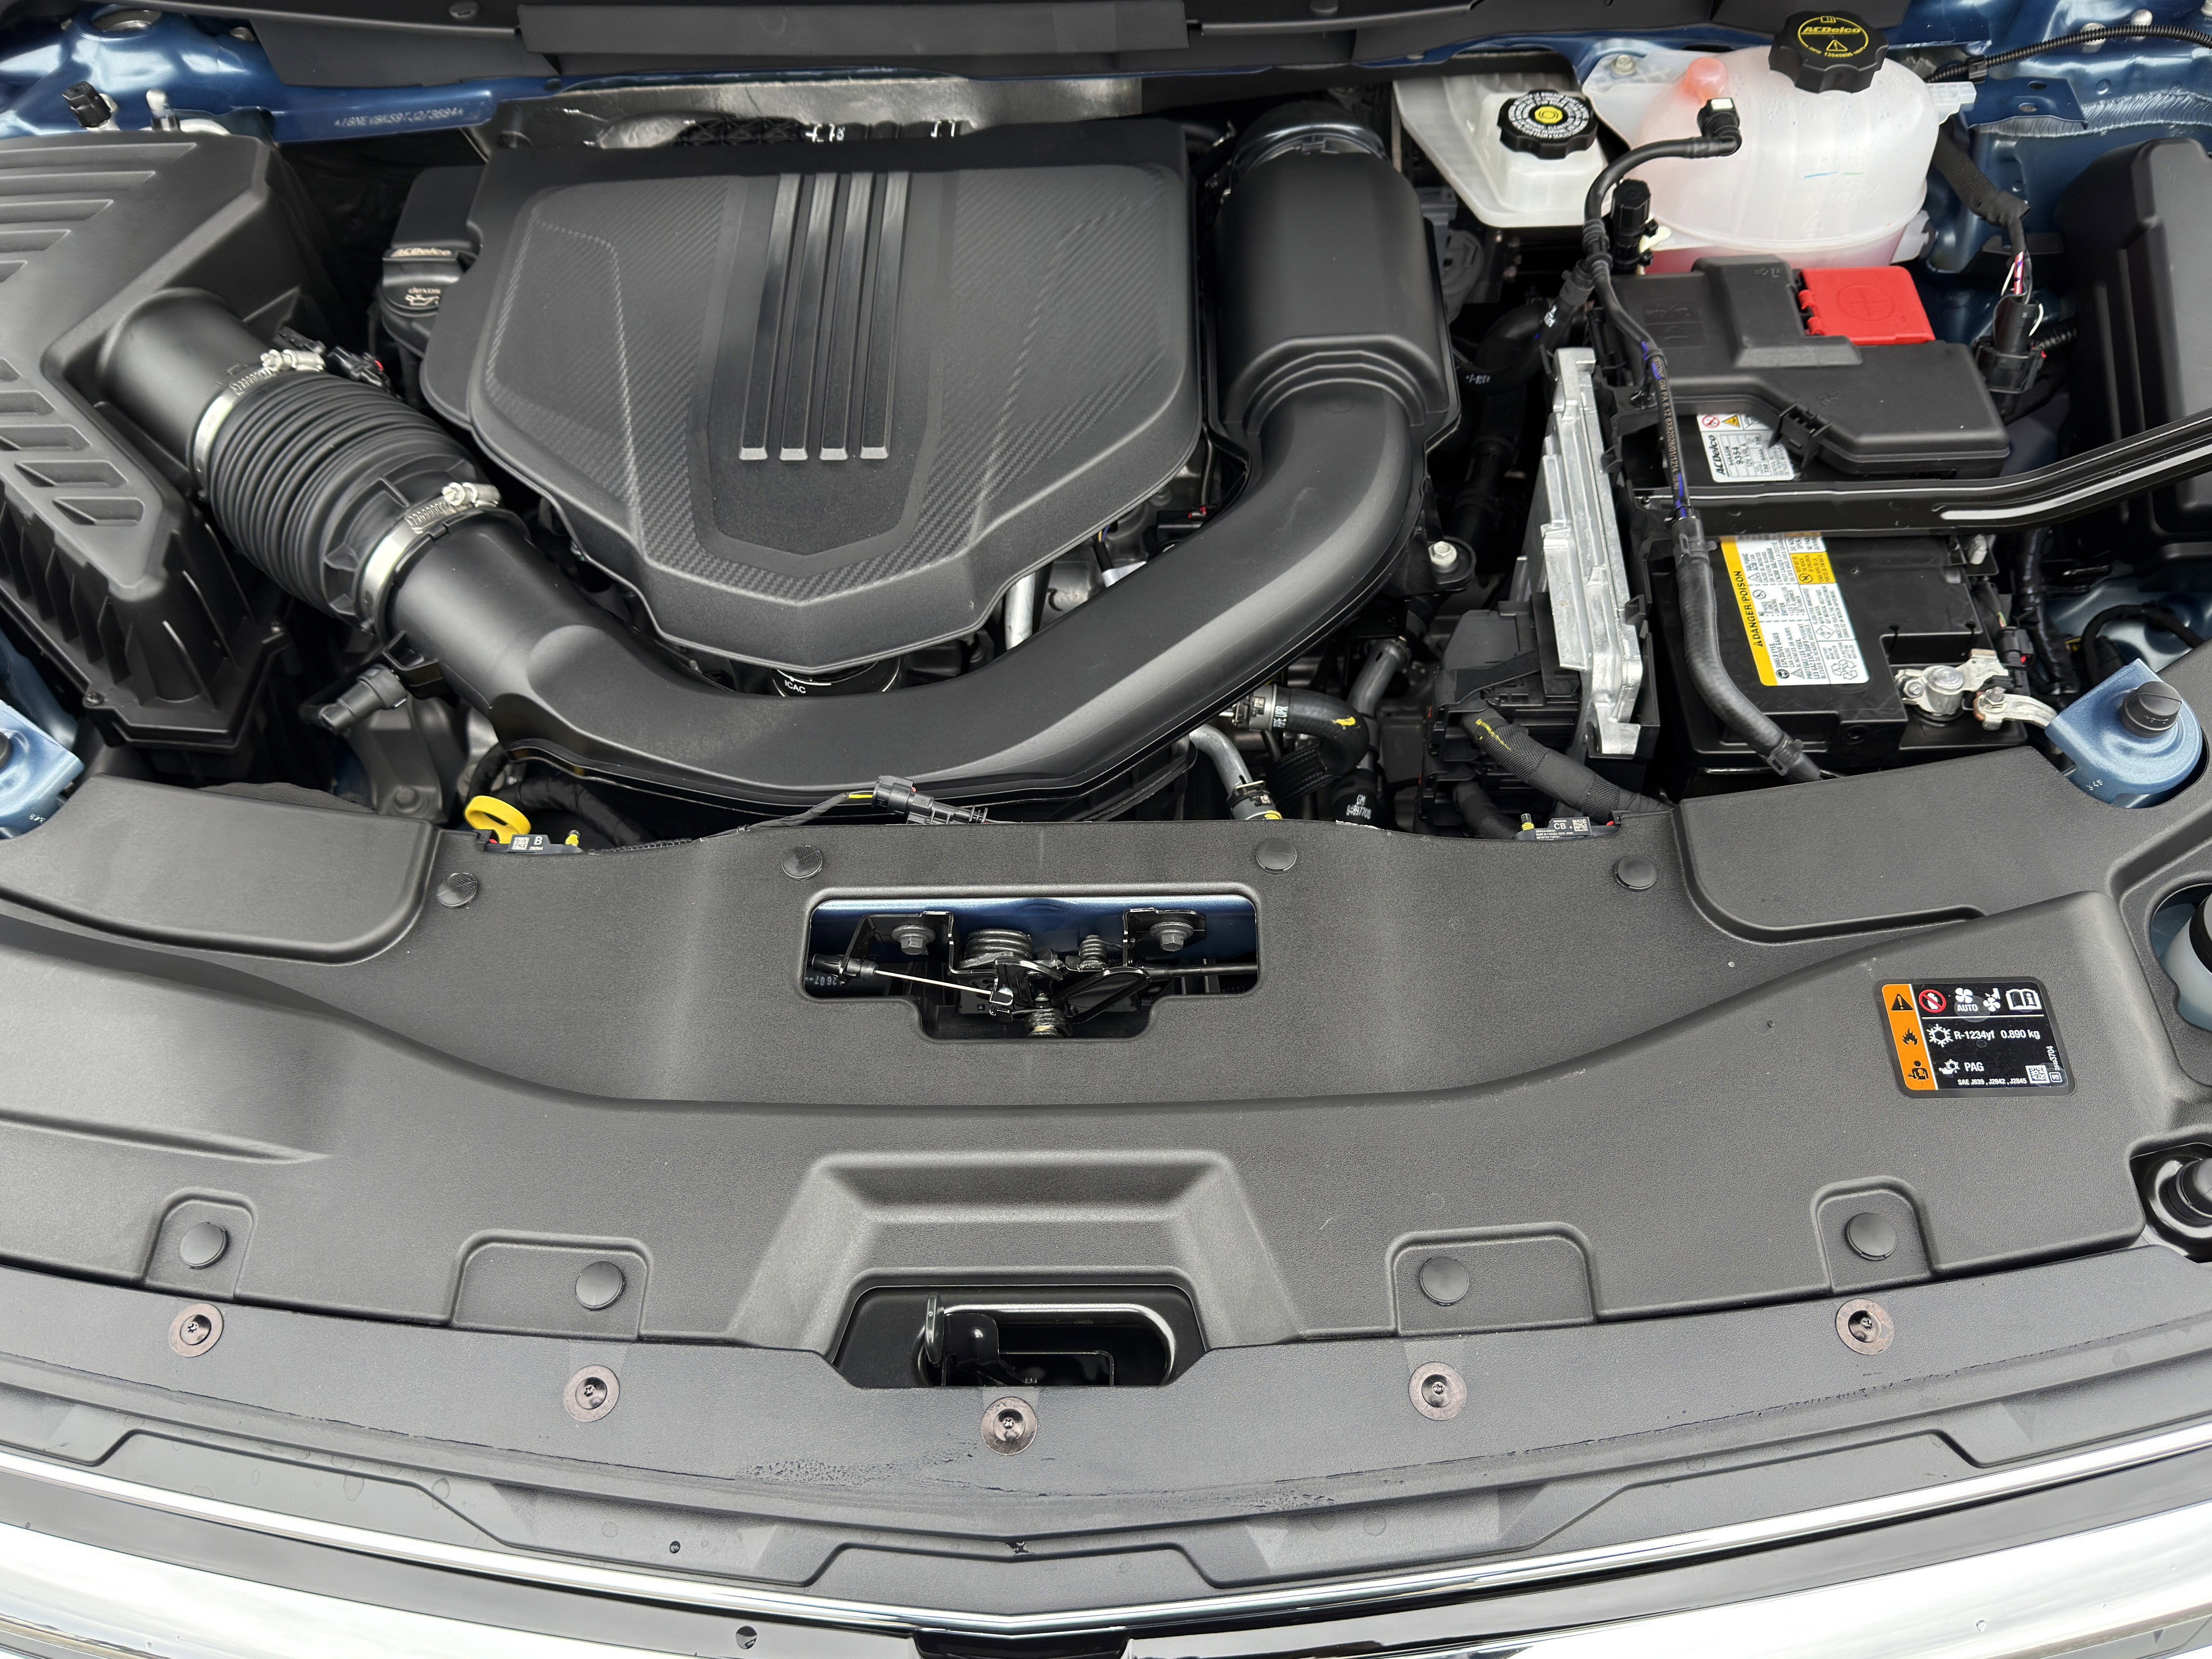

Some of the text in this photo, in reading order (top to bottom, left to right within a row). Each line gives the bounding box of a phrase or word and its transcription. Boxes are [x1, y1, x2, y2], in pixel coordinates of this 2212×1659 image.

[1709, 435, 1726, 476] ACDelco
[1732, 447, 1744, 465] 9354
[1732, 571, 1761, 639] DANGER/POISON
[785, 679, 806, 694] ICAC
[1356, 794, 1366, 806] GM
[534, 836, 543, 845] B
[1957, 1004, 1978, 1012] AUTO
[1954, 1029, 2040, 1041] R-1234yf 0.890 kg
[1964, 1062, 1985, 1072] PAG
